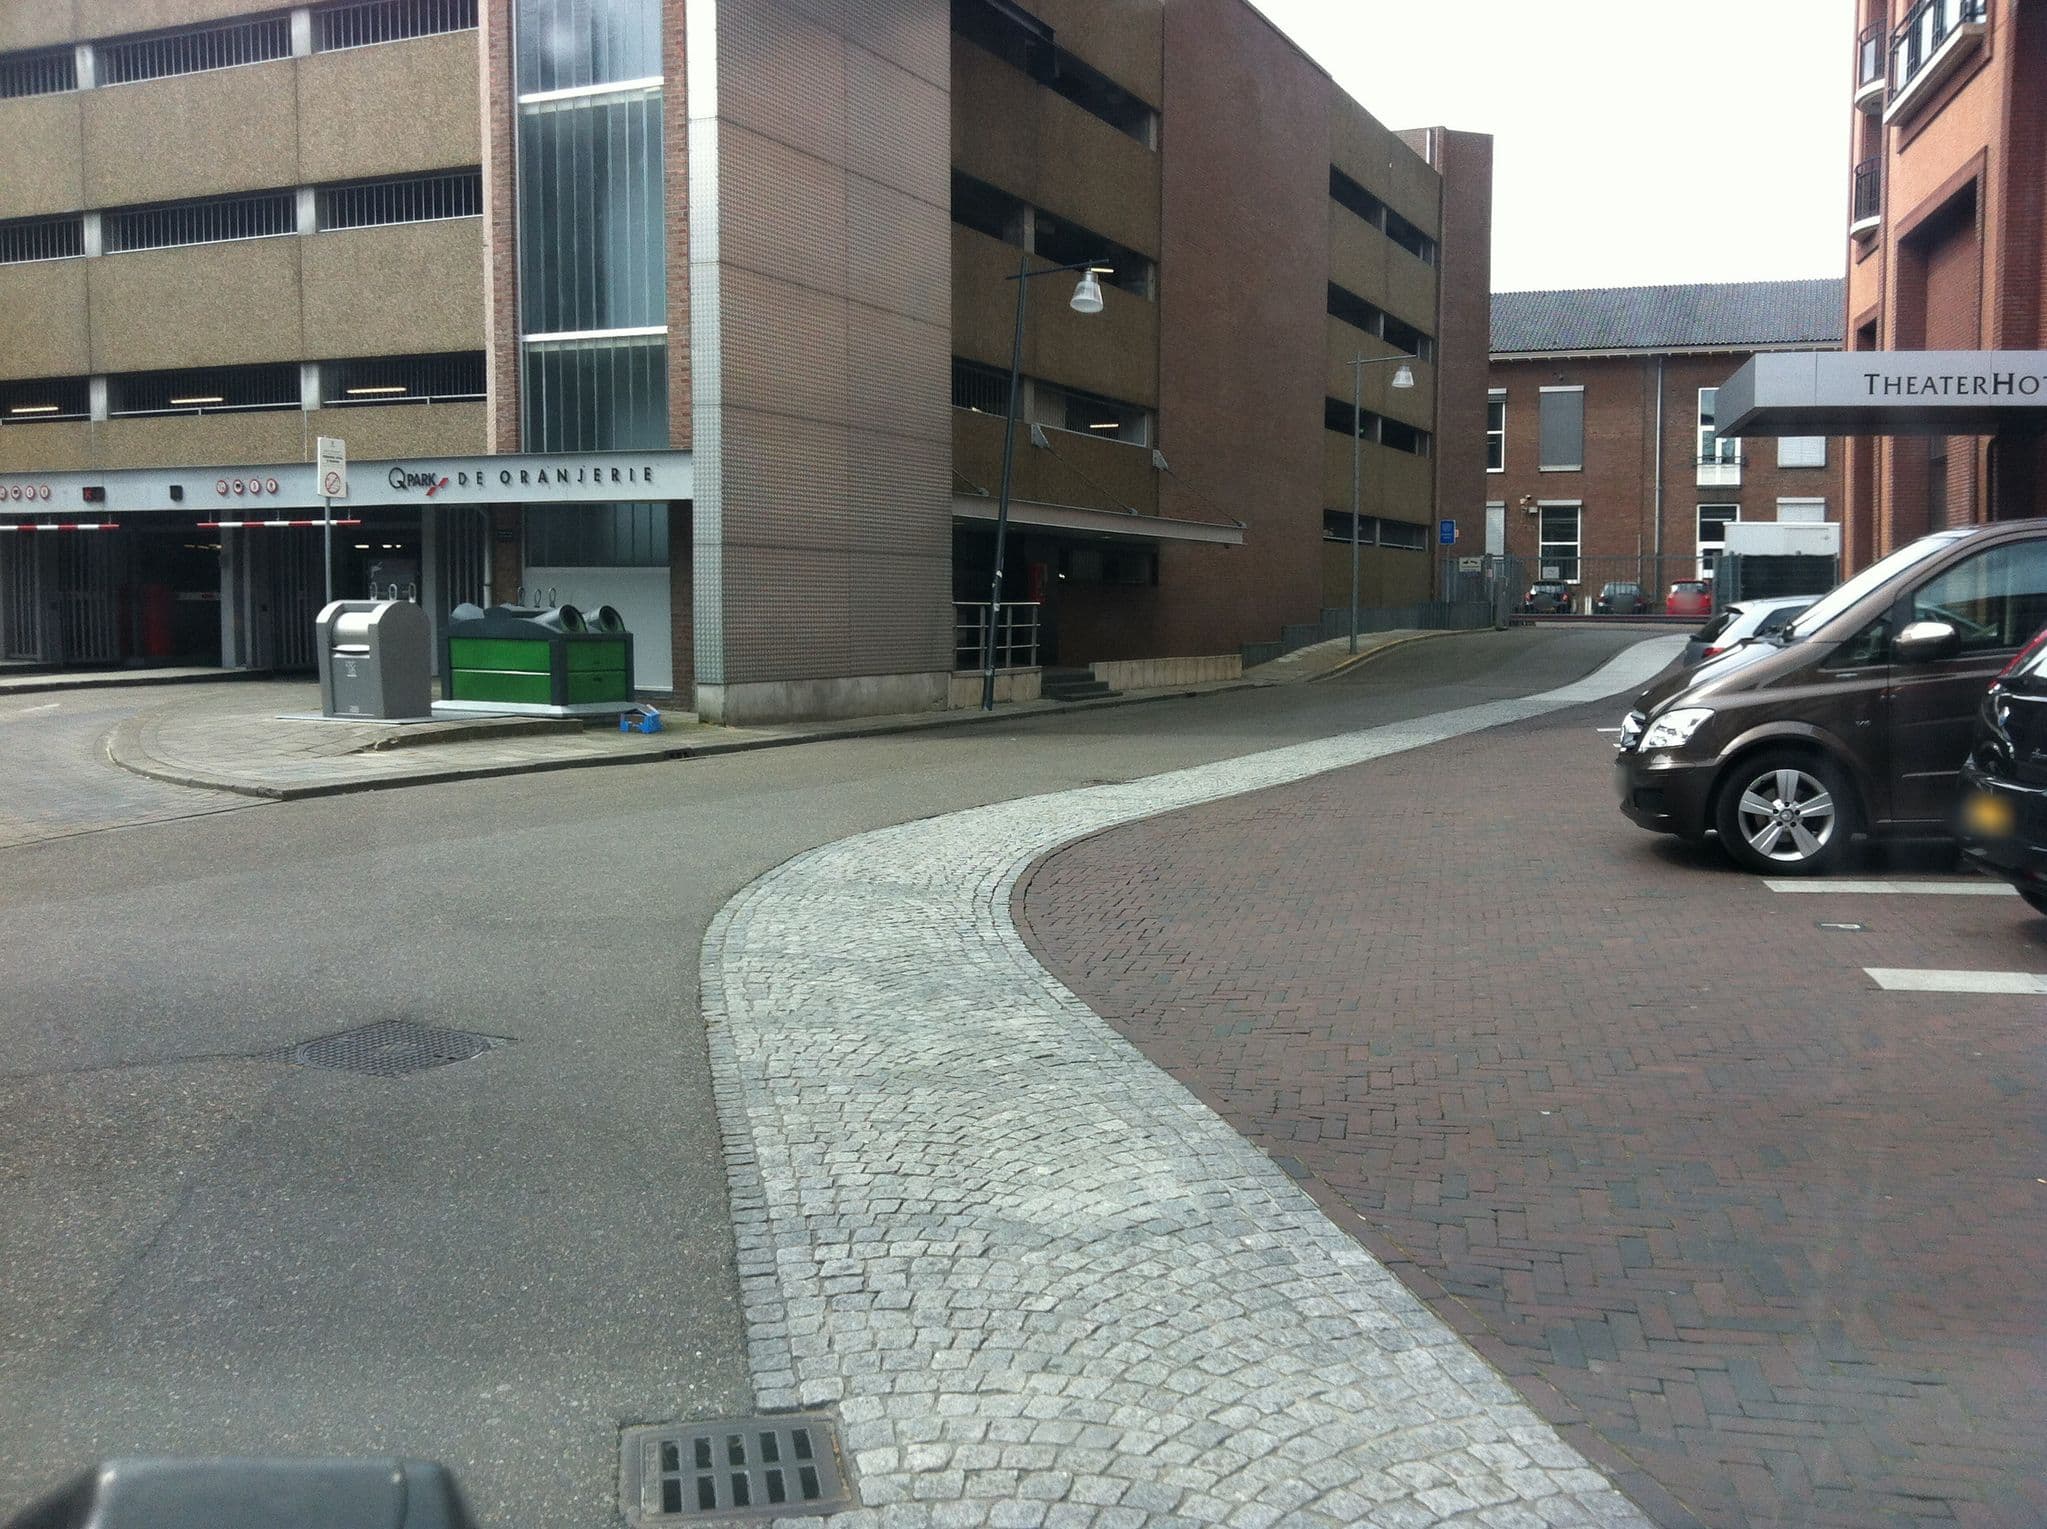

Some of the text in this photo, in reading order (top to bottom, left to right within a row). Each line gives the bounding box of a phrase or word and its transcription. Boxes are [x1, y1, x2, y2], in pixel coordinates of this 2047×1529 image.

[1864, 372, 2047, 395] THEATERHO
[458, 471, 483, 486] DE
[500, 467, 652, 485] ORANJERIE
